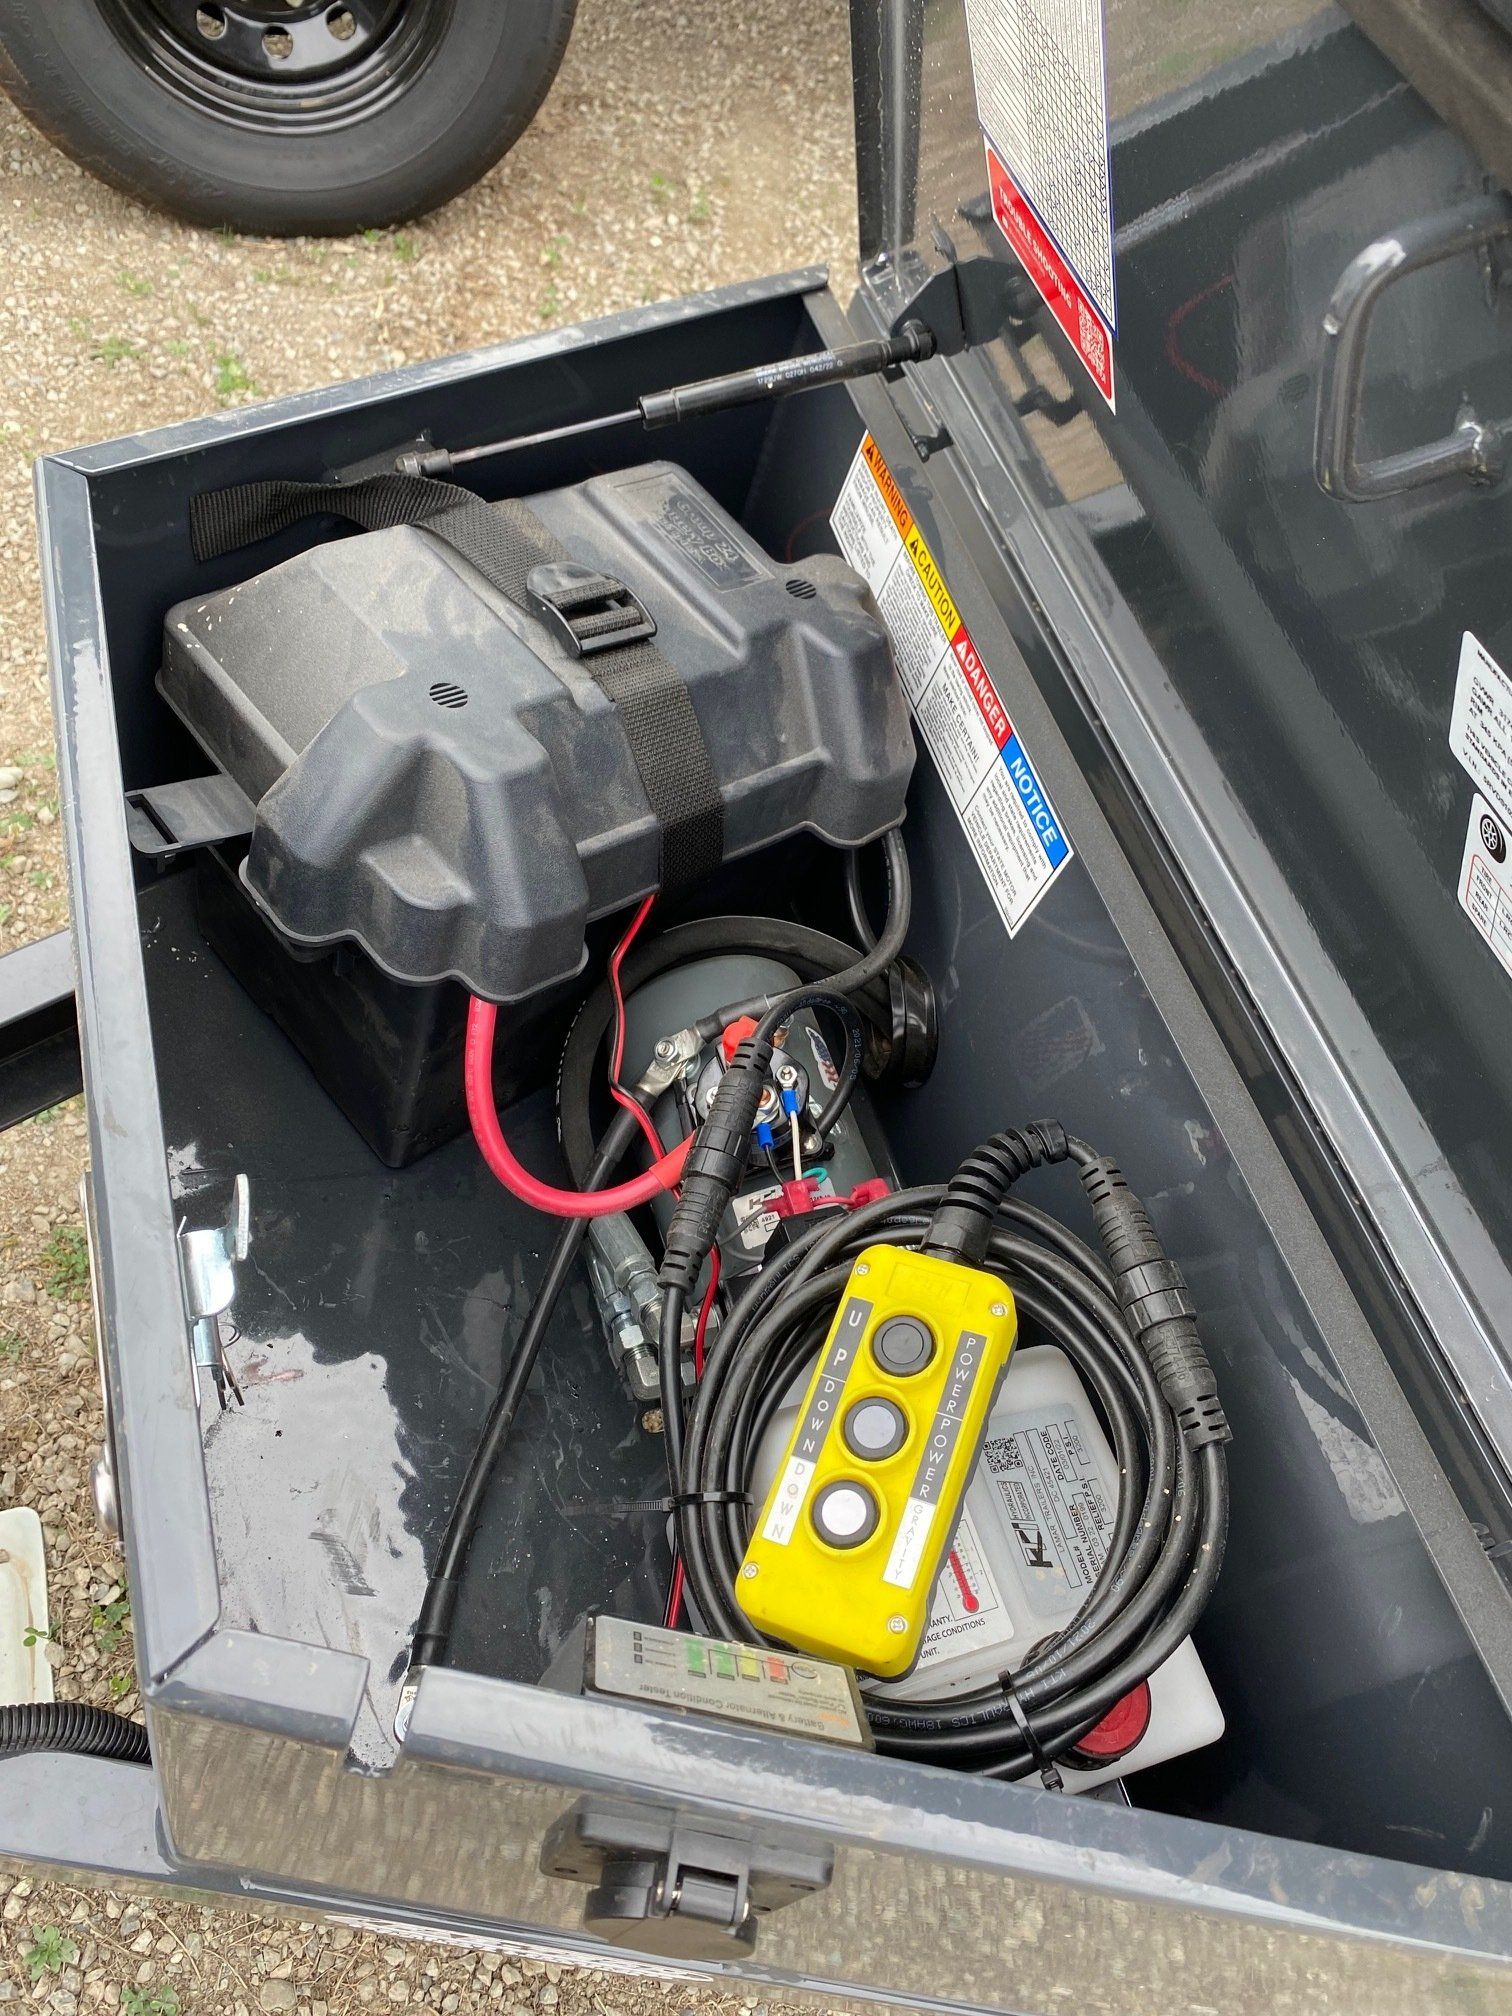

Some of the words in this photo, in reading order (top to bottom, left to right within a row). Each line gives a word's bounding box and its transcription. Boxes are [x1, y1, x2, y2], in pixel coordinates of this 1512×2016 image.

[999, 184, 1031, 245] TROUBLE
[1032, 239, 1071, 308] SHOOTING
[873, 452, 907, 527] WARNING
[918, 550, 955, 629] CAUTION
[964, 652, 1005, 737] DANGER
[942, 682, 957, 714] MAKE
[955, 713, 979, 762] CERTAIN!
[1010, 757, 1057, 846] NOTICE
[967, 817, 977, 837] MORE
[971, 811, 985, 841] VEHICLE
[983, 840, 1006, 887] DEPARTMENT
[1005, 888, 1013, 904] FOR
[993, 846, 1004, 868] STATE
[1003, 869, 1016, 897] MOTOR
[1476, 874, 1492, 898] FRONT
[1481, 866, 1491, 883] TIRE
[1471, 902, 1486, 926] SPARE
[1475, 891, 1488, 911] REAR
[945, 1337, 977, 1414] POWER
[802, 1379, 835, 1454] DOWN
[919, 1418, 952, 1499] POWER
[1040, 1431, 1054, 1455] CODE
[1071, 1435, 1083, 1452] 3200
[1027, 1465, 1037, 1479] INC
[1050, 1456, 1064, 1480] DATE
[771, 1462, 806, 1541] DOWN
[1000, 1480, 1019, 1520] HYDRAULICS
[1012, 1481, 1031, 1521] INCORPORATED
[1033, 1482, 1052, 1520] TRAILERS
[1087, 1499, 1104, 1530] RELIEF
[1095, 1494, 1106, 1512] 3200
[1049, 1524, 1065, 1553] LAMAR
[1068, 1503, 1088, 1543] NUMBER
[893, 1503, 925, 1581] GRAVITY
[1073, 1545, 1092, 1584] MODEL#
[942, 1618, 986, 1639] CONDITIONS
[920, 1647, 940, 1659] UNIT.
[639, 1684, 671, 1698] Tester
[672, 1690, 723, 1709] Condition
[726, 1702, 776, 1720] Alternator
[777, 1713, 785, 1722] &
[787, 1713, 824, 1731] Battery
